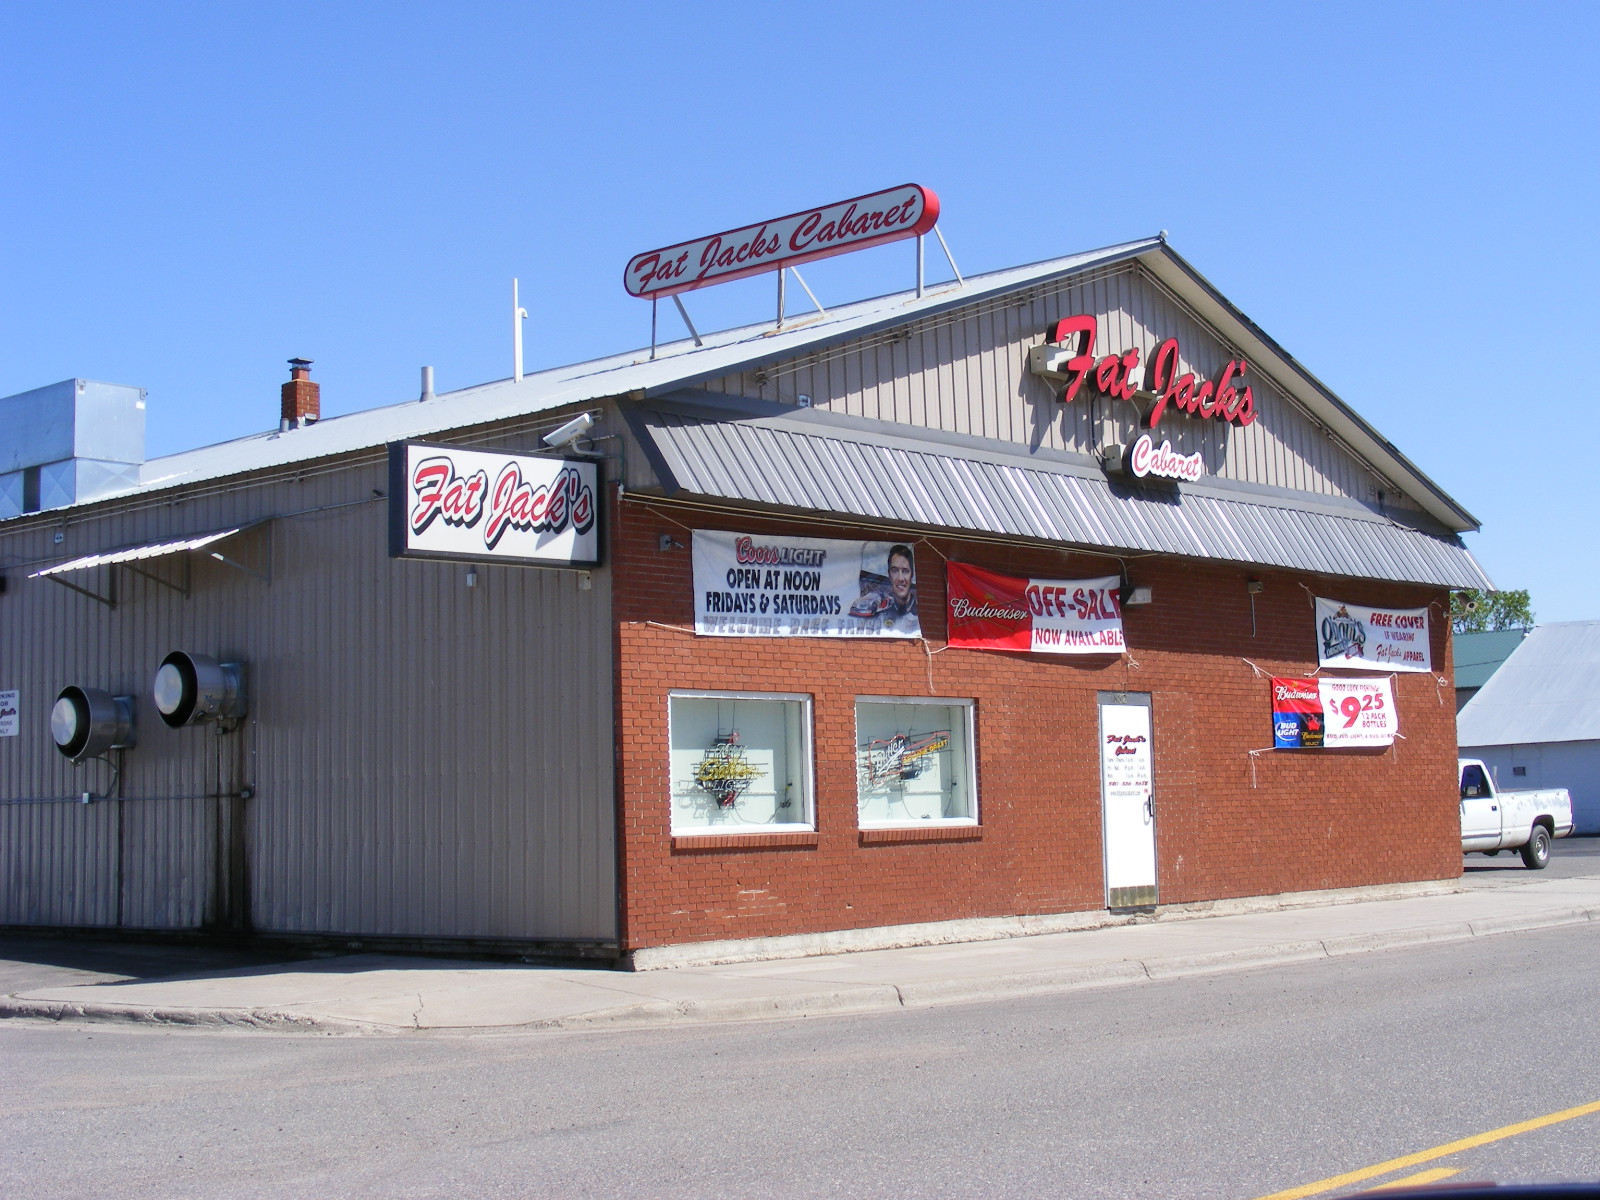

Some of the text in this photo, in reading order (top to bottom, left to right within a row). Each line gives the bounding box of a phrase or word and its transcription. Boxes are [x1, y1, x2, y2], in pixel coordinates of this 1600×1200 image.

[634, 195, 916, 293] Fat Jacks Cabaret
[1048, 314, 1140, 403] Fat
[1132, 435, 1201, 481] Cabaret
[411, 457, 594, 550] Fat Jack's
[736, 537, 826, 567] Coors LIGHT
[726, 568, 821, 591] OPEN AT NOON
[705, 591, 842, 615] FRIDAYS & SATURDAYS
[950, 598, 1029, 621] Budweiser
[703, 615, 781, 635] WELCOME
[789, 617, 829, 635] RACE
[1370, 612, 1424, 629] FREE COVER
[1035, 627, 1062, 646] NOW
[1384, 630, 1415, 642] IF WEARING
[1376, 643, 1388, 662] Fat
[1403, 651, 1425, 662] APPAREL
[1275, 686, 1318, 700] Budweiser
